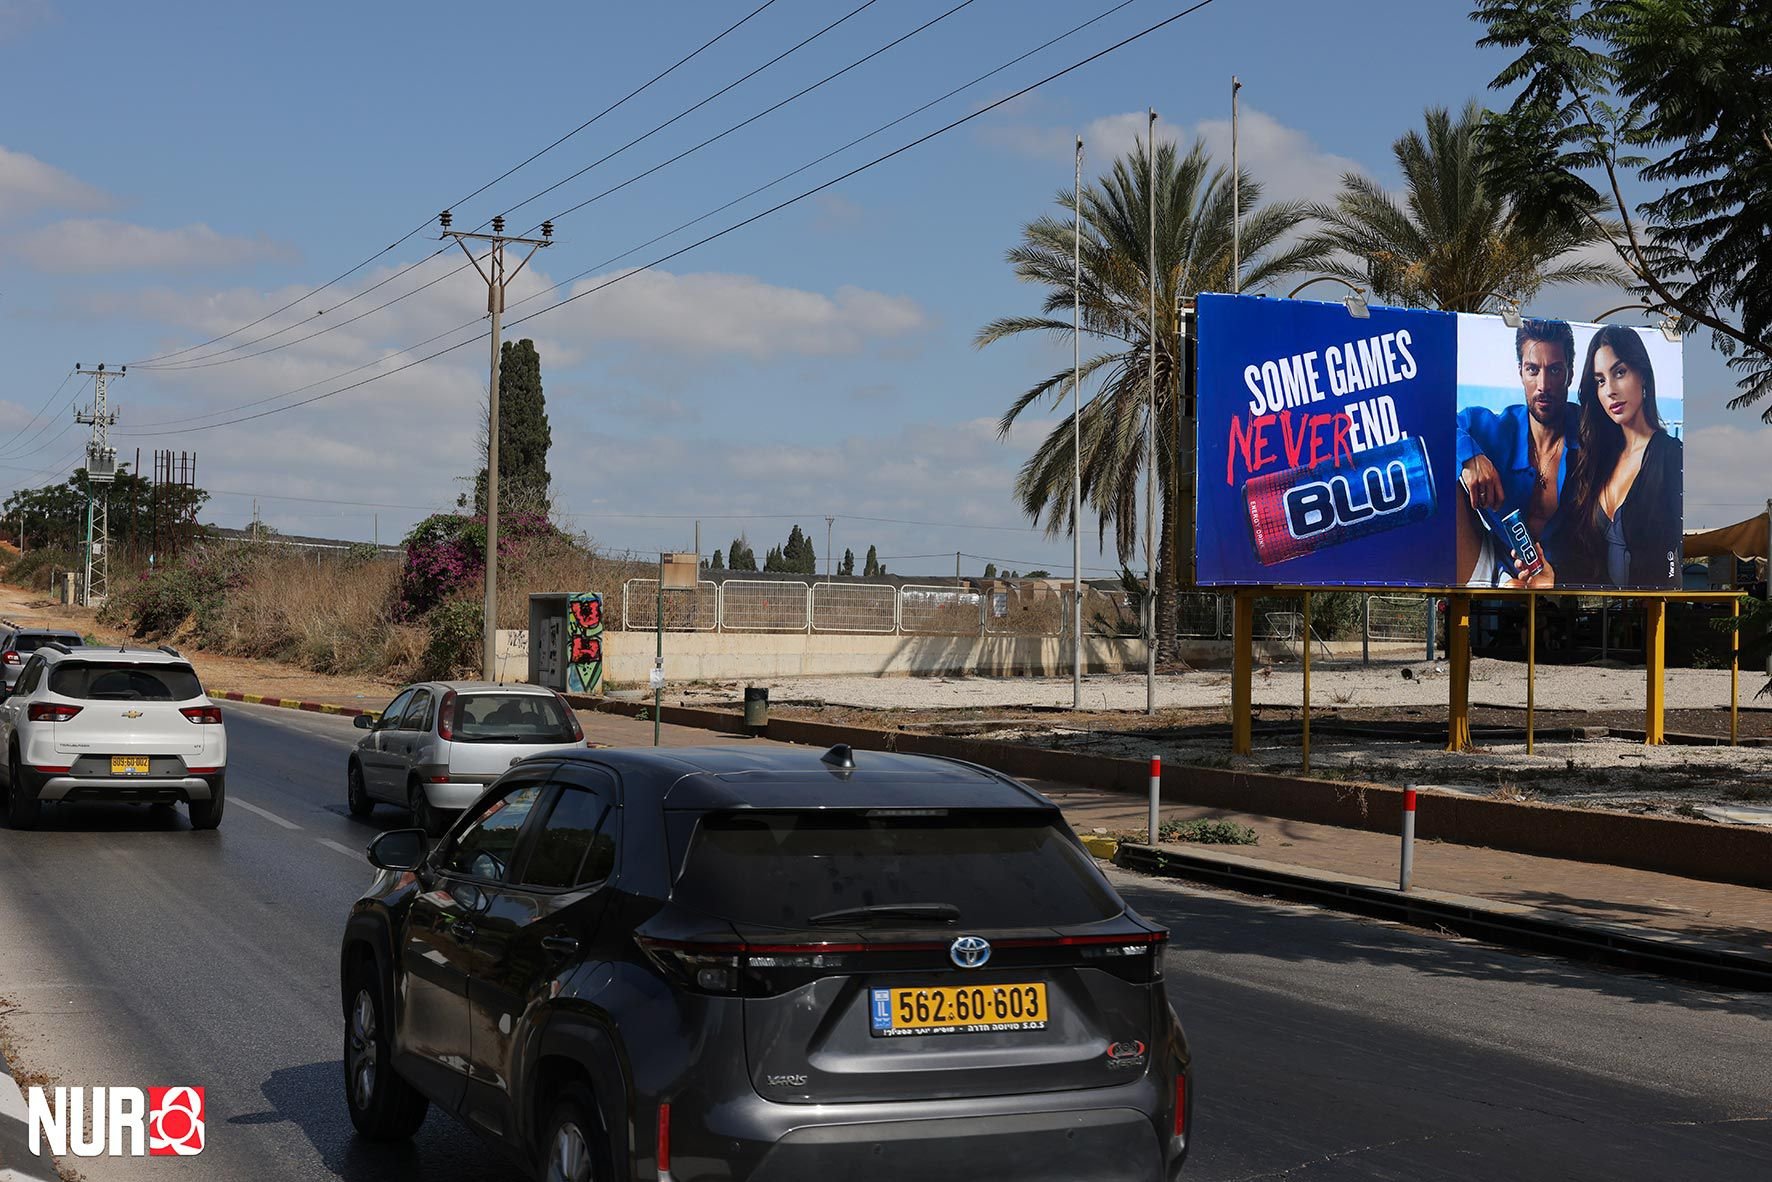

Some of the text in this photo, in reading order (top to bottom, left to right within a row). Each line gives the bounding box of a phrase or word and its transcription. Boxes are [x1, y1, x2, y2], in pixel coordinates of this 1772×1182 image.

[1243, 329, 1418, 417] SOME GAMES
[1227, 395, 1408, 486] NEVER END.
[1282, 460, 1411, 540] BLU
[1511, 521, 1539, 566] BLU
[877, 1001, 889, 1017] IL
[967, 1024, 990, 1032] חדרה
[991, 1022, 1020, 1031] טויוטה
